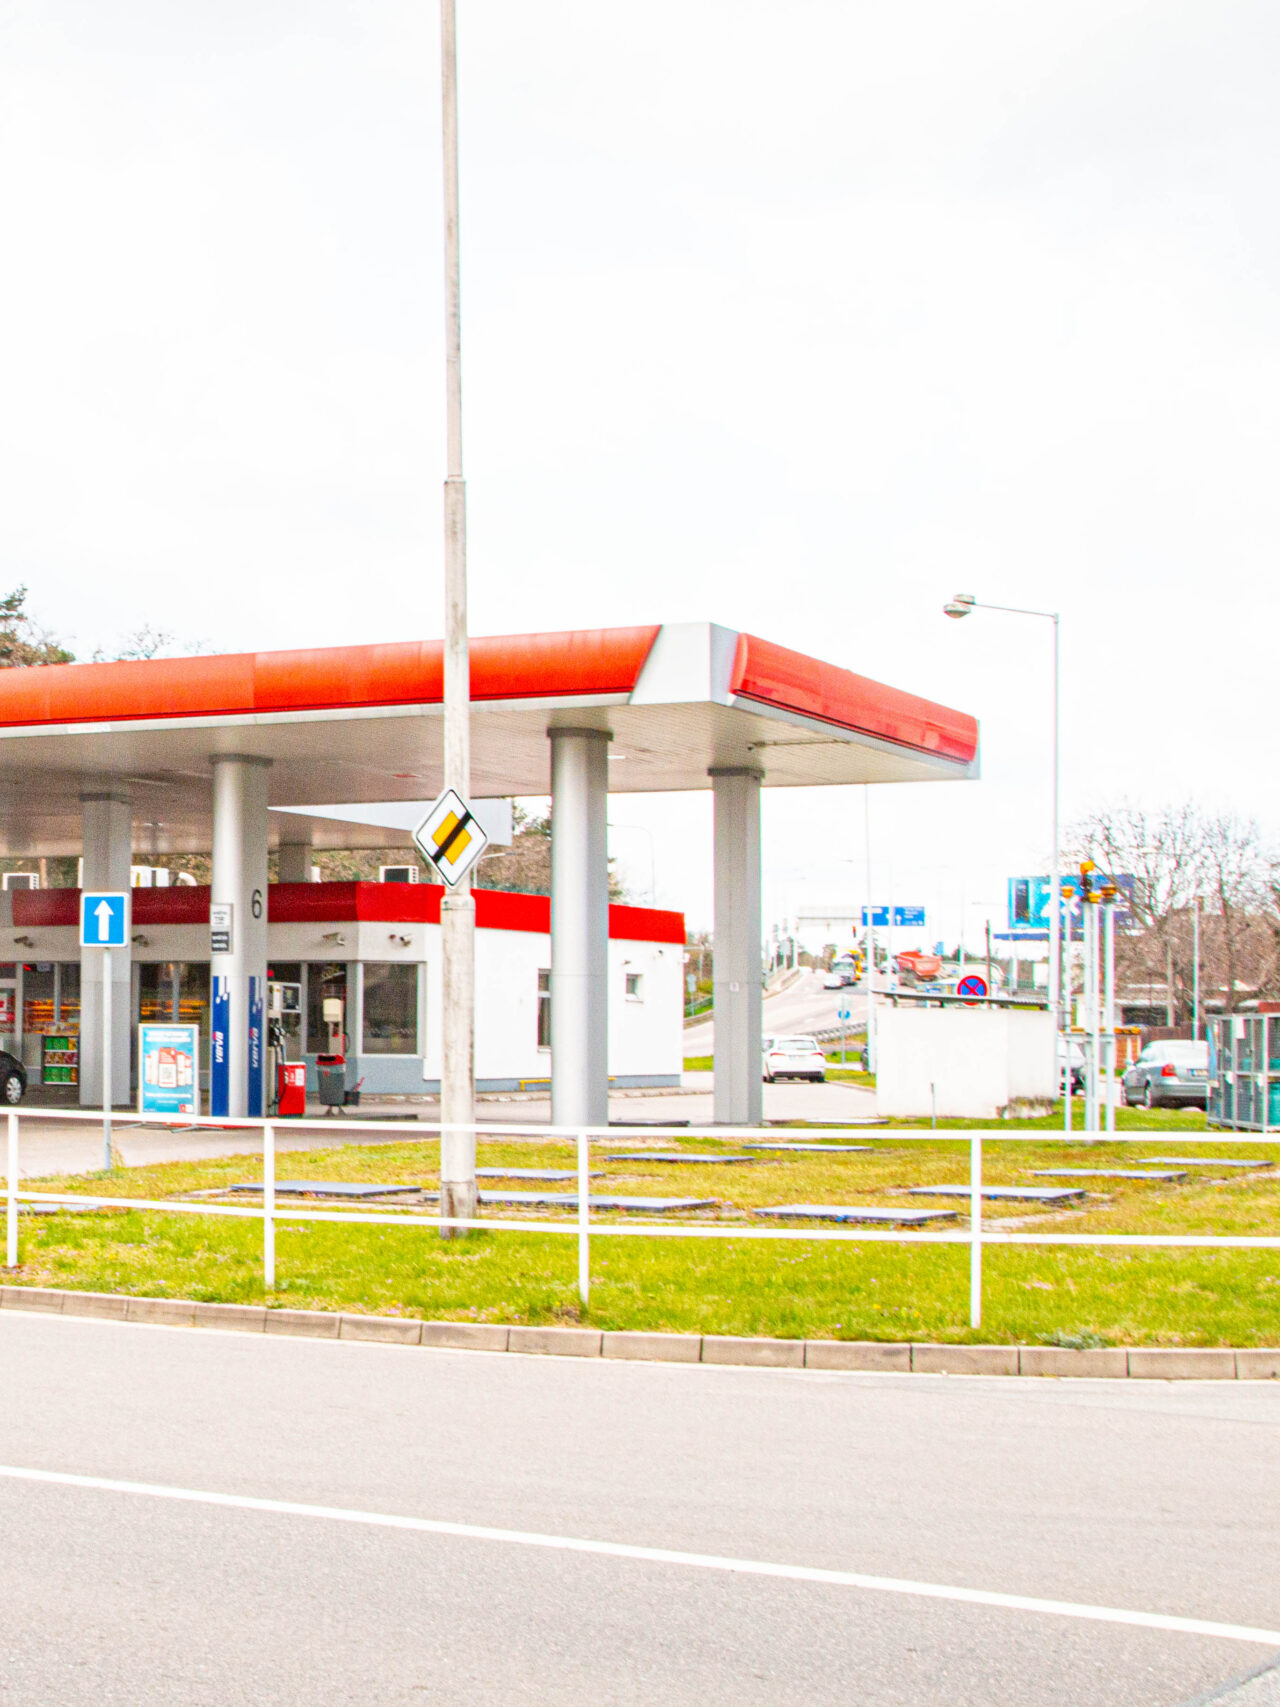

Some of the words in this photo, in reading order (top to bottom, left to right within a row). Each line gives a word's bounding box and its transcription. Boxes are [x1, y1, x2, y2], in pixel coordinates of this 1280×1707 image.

[251, 888, 263, 919] 6
[215, 1031, 224, 1063] verva
[251, 1027, 260, 1069] verva
